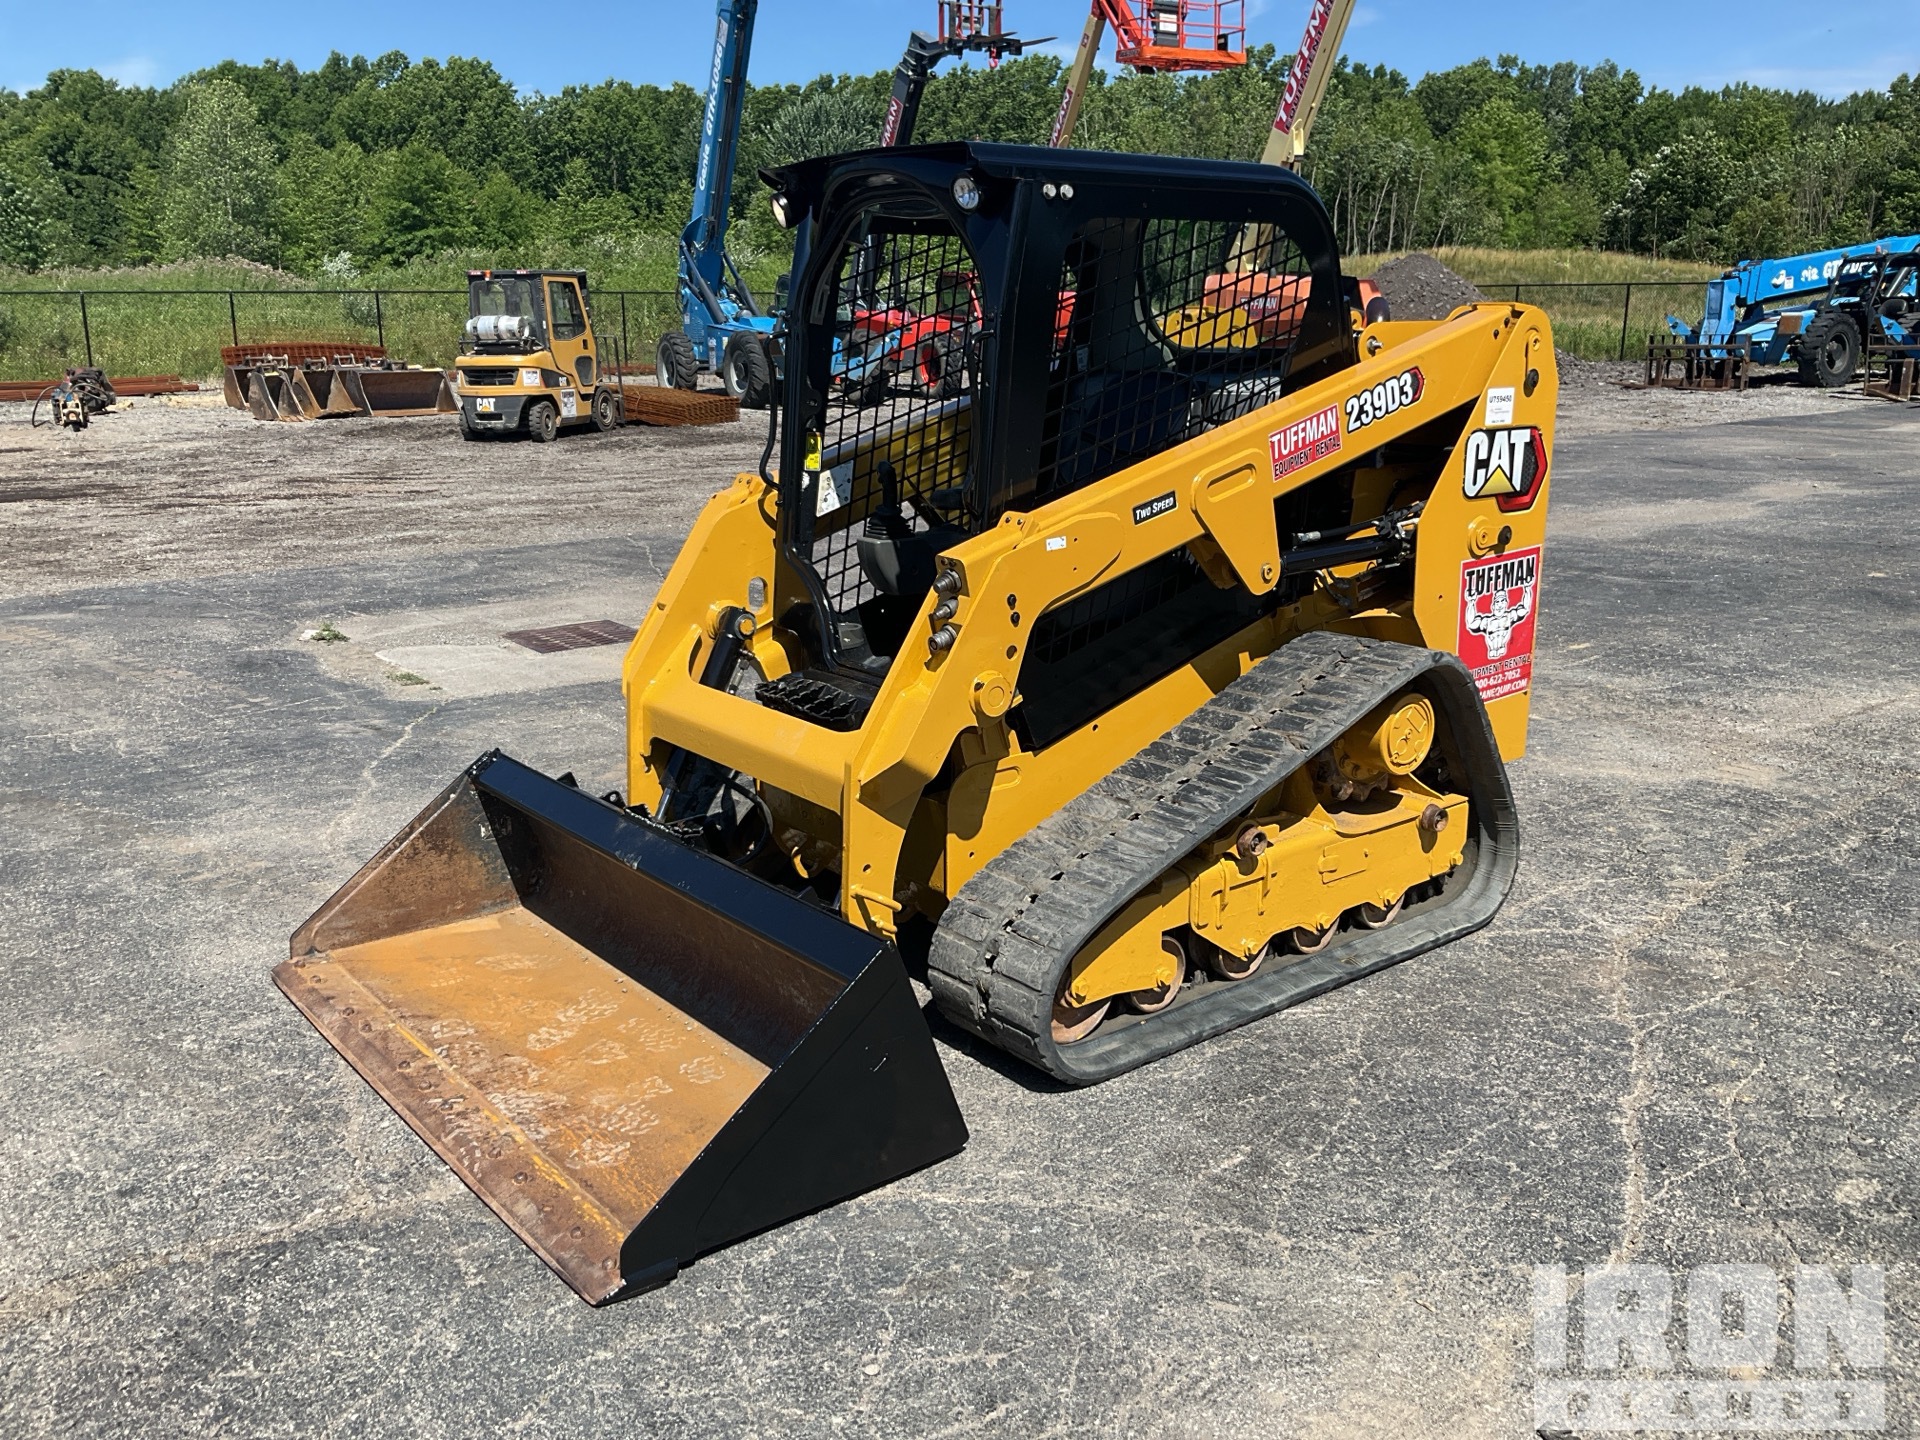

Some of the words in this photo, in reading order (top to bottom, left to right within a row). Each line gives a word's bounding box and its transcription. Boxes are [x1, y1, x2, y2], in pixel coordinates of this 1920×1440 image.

[1277, 0, 1327, 122] TUFFM
[1285, 29, 1323, 131] EQUIPMENT
[699, 143, 711, 191] Genie
[705, 42, 723, 136] GTH-1056
[476, 398, 496, 412] CAT
[1346, 371, 1413, 431] 239D3
[1270, 408, 1336, 459] TUFFMAN
[1274, 448, 1312, 477] EQUIPMENT
[1315, 434, 1341, 457] RENTAL
[1464, 429, 1531, 497] CAT
[1466, 556, 1535, 597] TUFFMAN
[1504, 653, 1531, 668] RENTAL
